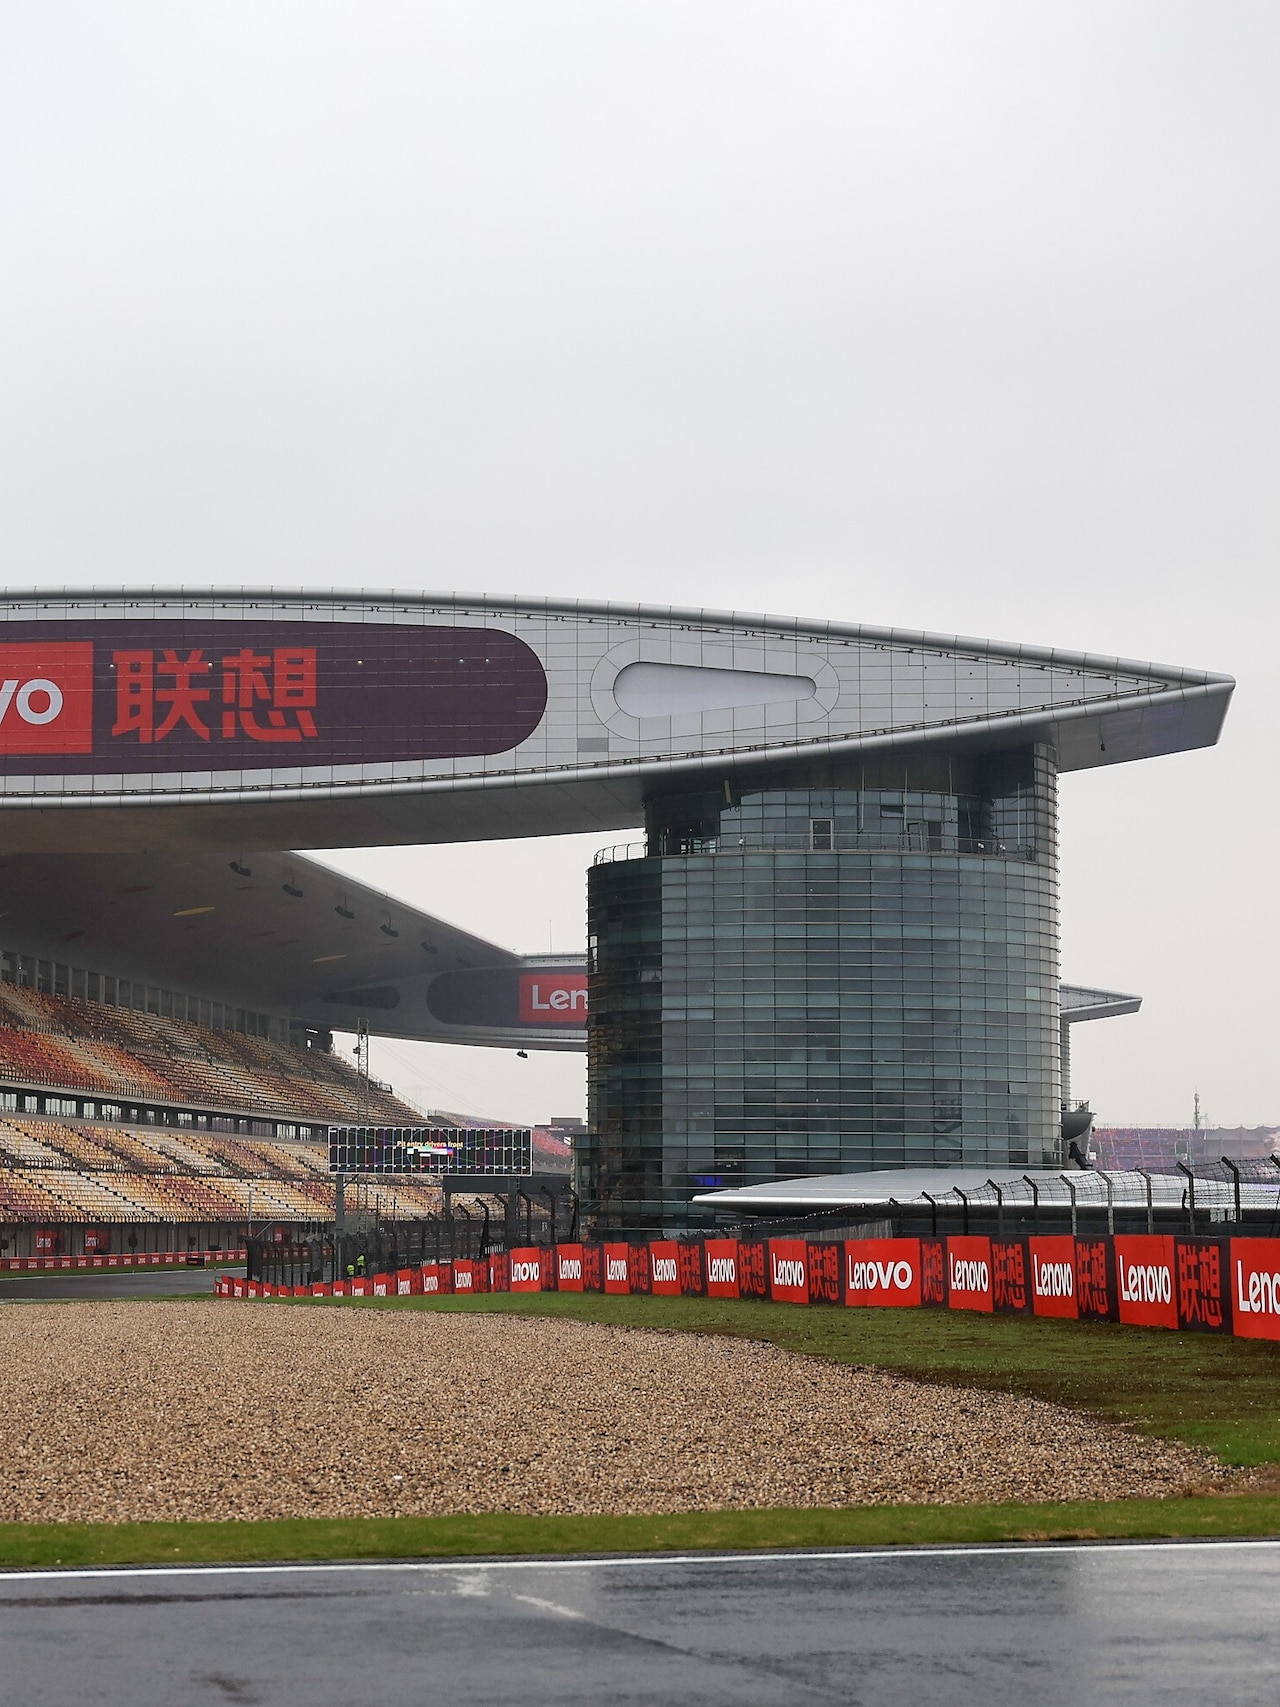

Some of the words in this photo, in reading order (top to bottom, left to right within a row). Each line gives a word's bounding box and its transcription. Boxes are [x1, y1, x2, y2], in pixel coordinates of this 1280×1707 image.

[111, 648, 319, 744] 联想
[532, 984, 588, 1010] Len
[708, 1253, 735, 1282] Lenovo
[773, 1253, 804, 1287] Lenovo
[849, 1255, 912, 1289] Lenovo
[950, 1253, 988, 1292] Lenovo
[1034, 1254, 1072, 1297] Lenovo
[1120, 1255, 1171, 1304] Lenovo
[1177, 1243, 1223, 1327] 联想
